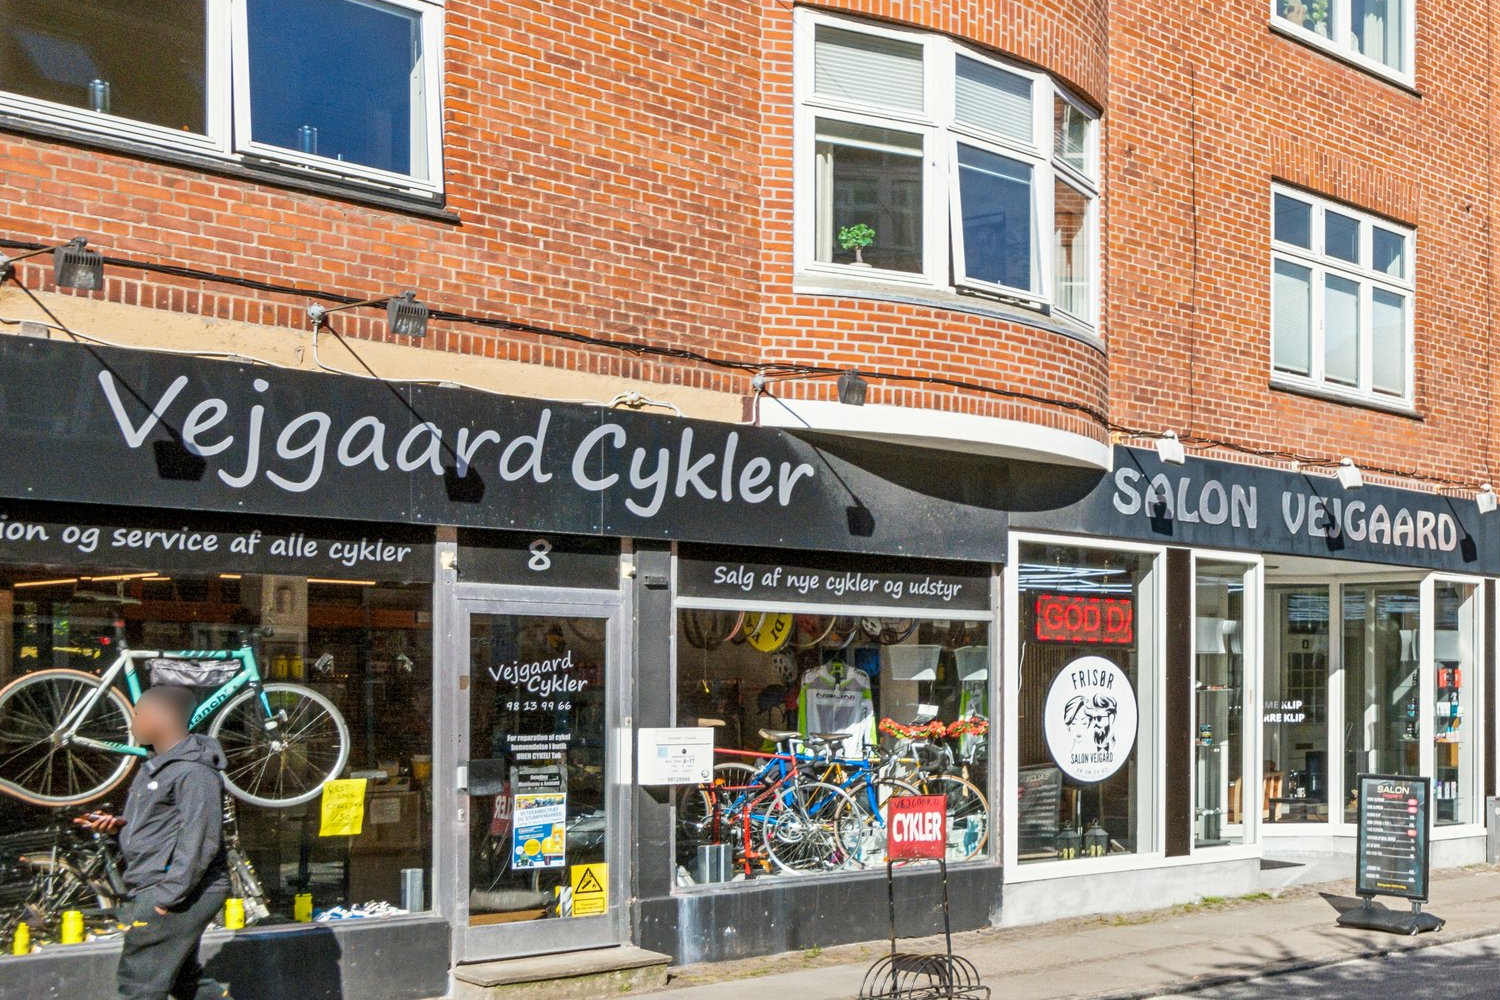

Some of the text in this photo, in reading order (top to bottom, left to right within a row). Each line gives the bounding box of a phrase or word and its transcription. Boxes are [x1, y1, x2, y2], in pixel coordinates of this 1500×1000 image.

[99, 370, 815, 518] Vejgaard Cykler
[1113, 467, 1458, 552] SALON VEJGAARD
[62, 525, 100, 553] og
[111, 527, 218, 552] service
[230, 530, 261, 555] af
[270, 533, 318, 558] alle
[328, 537, 411, 566] cykler
[528, 539, 552, 571] 8
[714, 566, 962, 600] Salg af nye cykler og udstyr
[1044, 603, 1100, 633] GOD
[488, 650, 574, 685] Vejgaard
[1071, 668, 1115, 691] FRISØR
[527, 674, 588, 697] Cykler
[506, 701, 572, 711] 98 13 99 66
[1281, 700, 1302, 710] KLIP
[1284, 713, 1305, 722] KLIP
[1071, 752, 1113, 764] SALON VEJGARD
[1377, 785, 1409, 795] SALON
[892, 811, 942, 843] CYKLER
